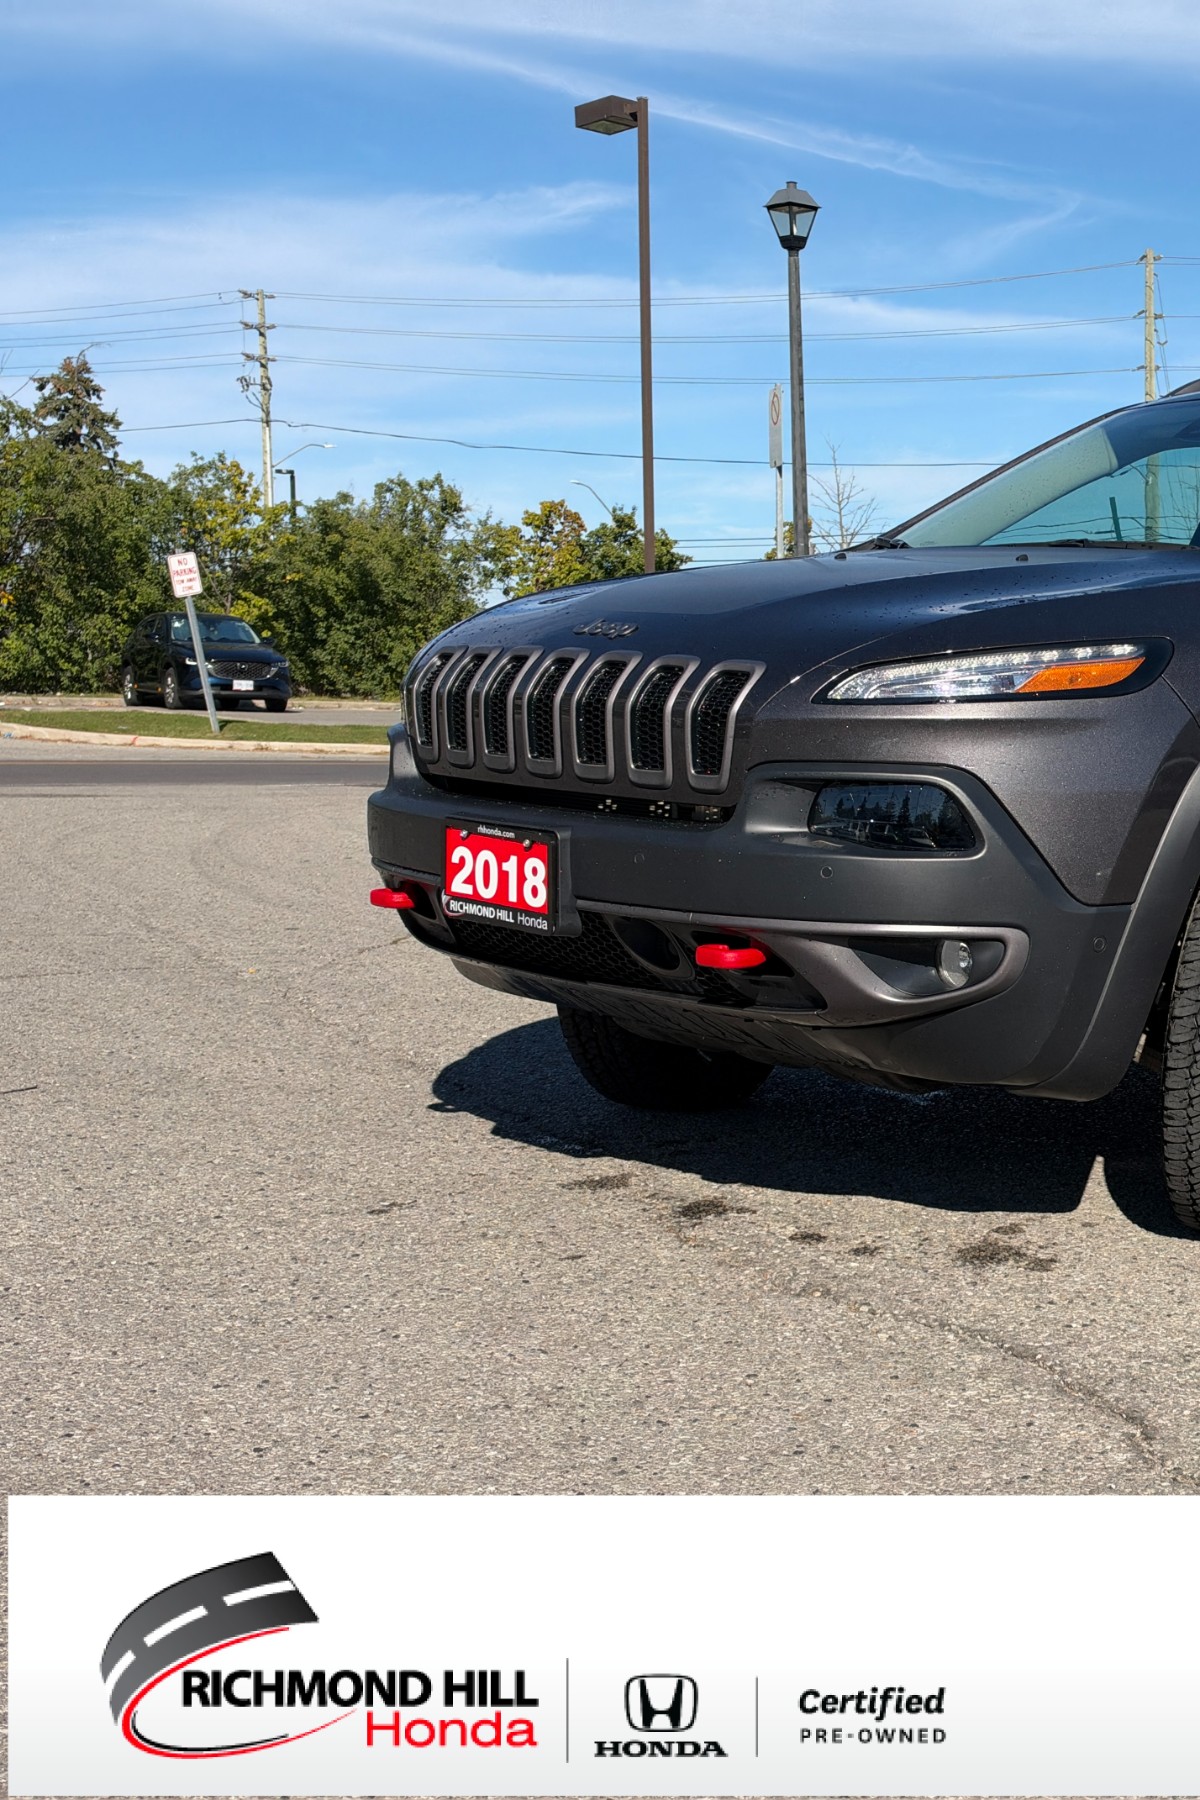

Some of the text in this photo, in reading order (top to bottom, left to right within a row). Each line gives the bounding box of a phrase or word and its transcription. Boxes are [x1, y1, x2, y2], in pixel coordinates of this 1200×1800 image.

[177, 557, 188, 566] NO
[173, 567, 196, 576] PARKING
[572, 618, 639, 640] Jeep
[477, 825, 516, 839] rhhonda.com
[450, 845, 547, 908] 2018
[449, 900, 548, 930] RICHMOND HILL Honda
